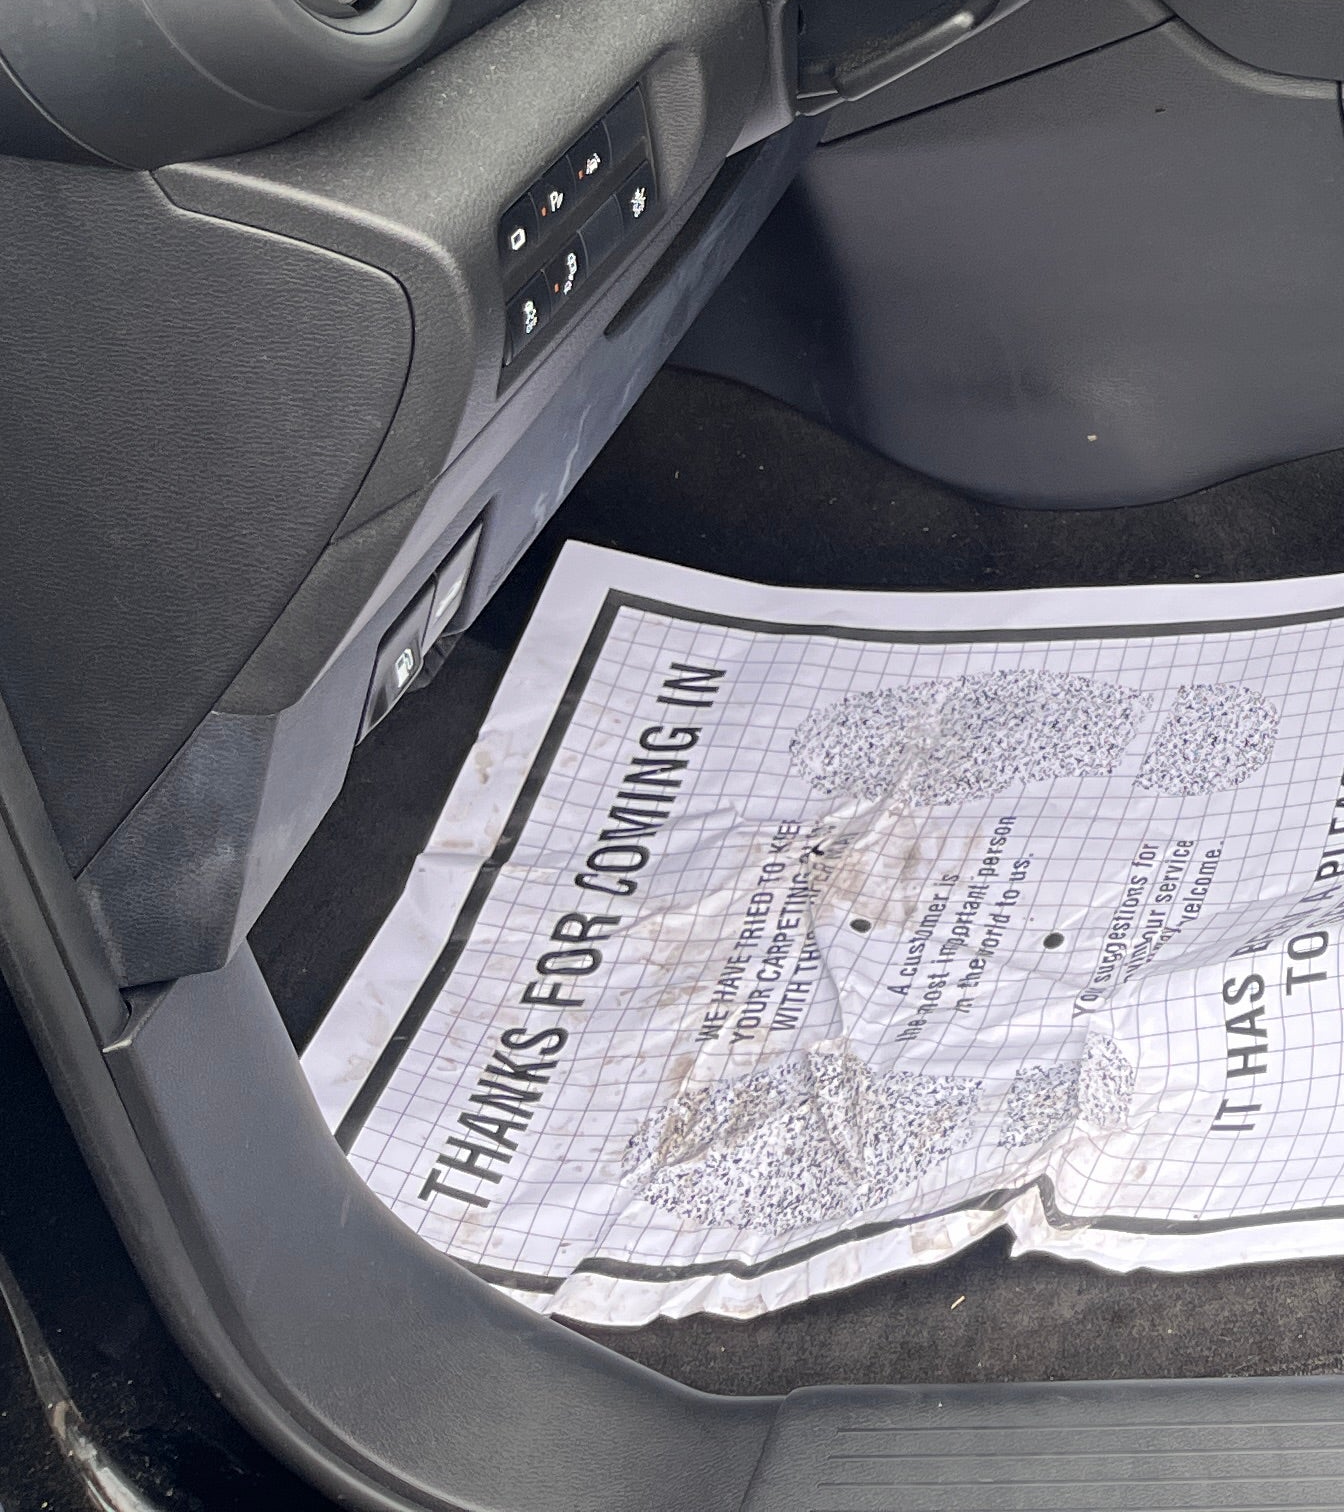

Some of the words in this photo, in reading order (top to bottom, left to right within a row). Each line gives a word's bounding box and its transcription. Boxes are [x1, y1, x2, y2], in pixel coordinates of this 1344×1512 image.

[977, 815, 1017, 878] person
[1131, 842, 1161, 869] for
[1155, 839, 1194, 904] service
[994, 889, 1021, 908] to
[418, 1026, 569, 1209] THANKS
[520, 910, 622, 1007] FOR
[574, 725, 703, 896] COMING
[655, 661, 727, 708] IN
[695, 1003, 729, 1044] WE
[712, 954, 752, 1004] HAVE
[733, 891, 775, 951] TRIED
[757, 862, 787, 888] TO
[887, 983, 911, 996] A
[899, 892, 949, 978] customer
[933, 873, 960, 888] is
[1286, 930, 1329, 996] TO
[729, 986, 772, 1045] YOUR
[769, 981, 813, 1033] WITH
[1222, 972, 1268, 1079] HAS
[1210, 1097, 1262, 1132] IT
